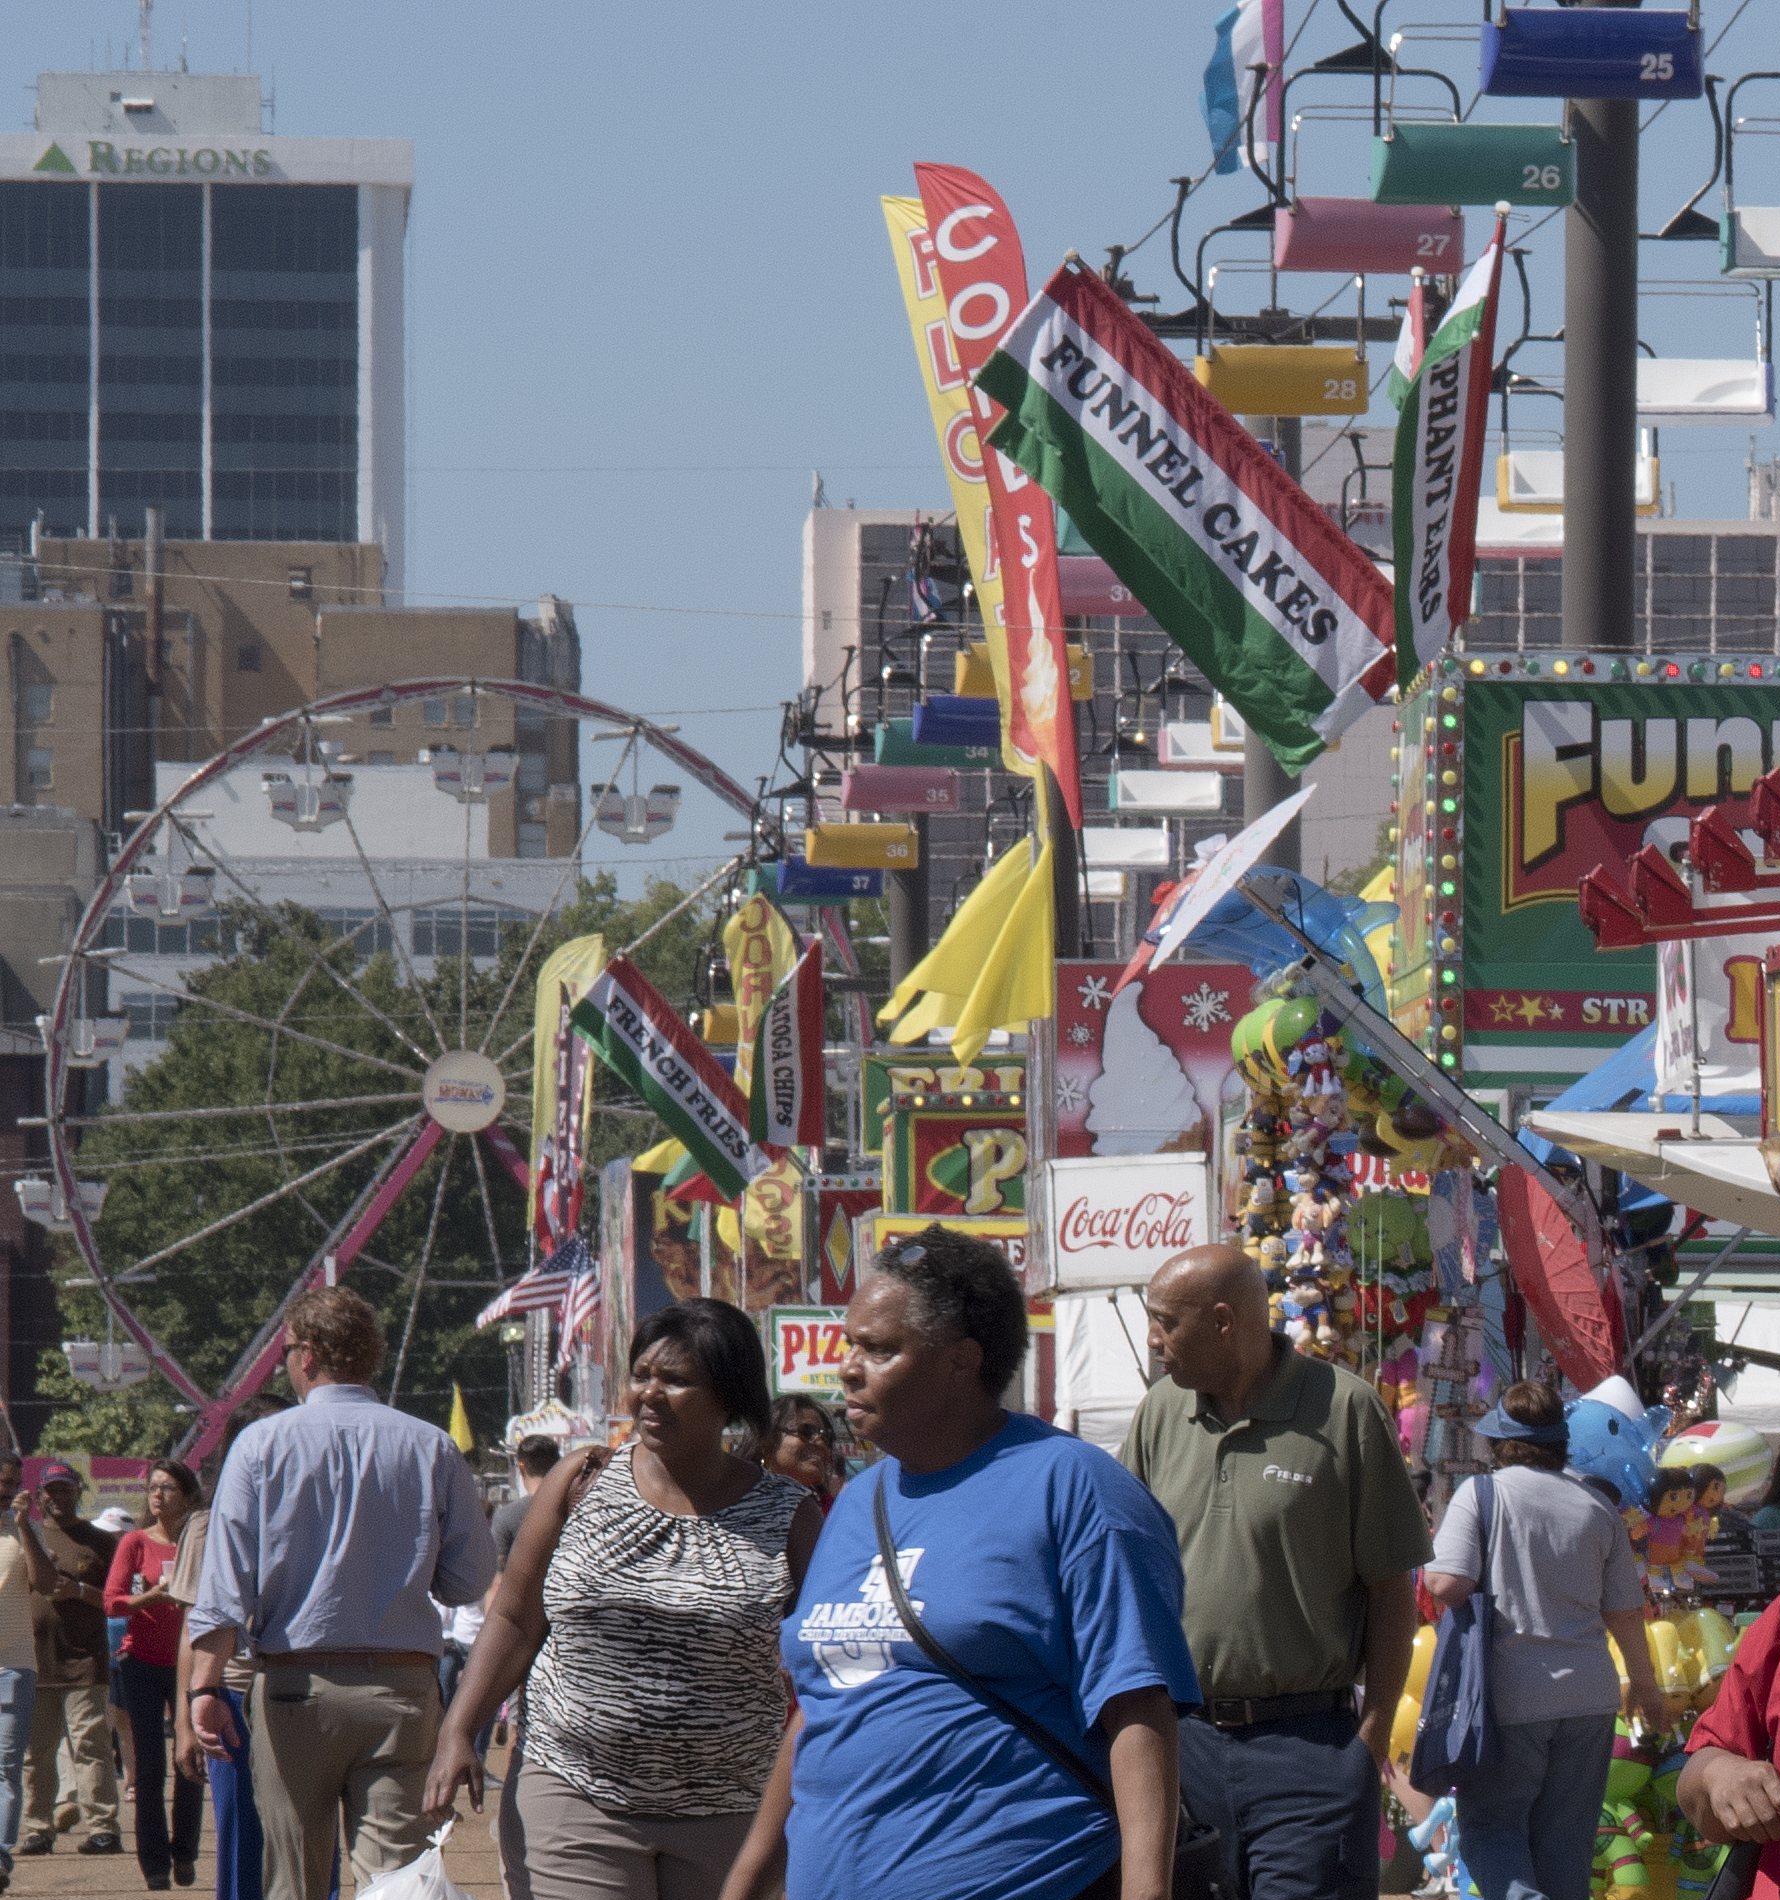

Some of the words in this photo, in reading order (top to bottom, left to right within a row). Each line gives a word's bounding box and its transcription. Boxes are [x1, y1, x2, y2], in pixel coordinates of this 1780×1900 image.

[1640, 53, 1674, 80] 25
[1522, 165, 1561, 190] 26
[1416, 233, 1450, 256] 27
[1324, 378, 1357, 400] 28
[1041, 334, 1205, 509] FUNNEL
[1203, 502, 1339, 646] CAKES
[1418, 518, 1449, 625] EARS
[925, 788, 949, 803] 35
[852, 875, 871, 890] 37
[607, 995, 693, 1094] FRENCH
[687, 1090, 749, 1160] FRIES
[775, 1067, 794, 1128] CHIPS
[1059, 1192, 1194, 1253] Coca-Cola
